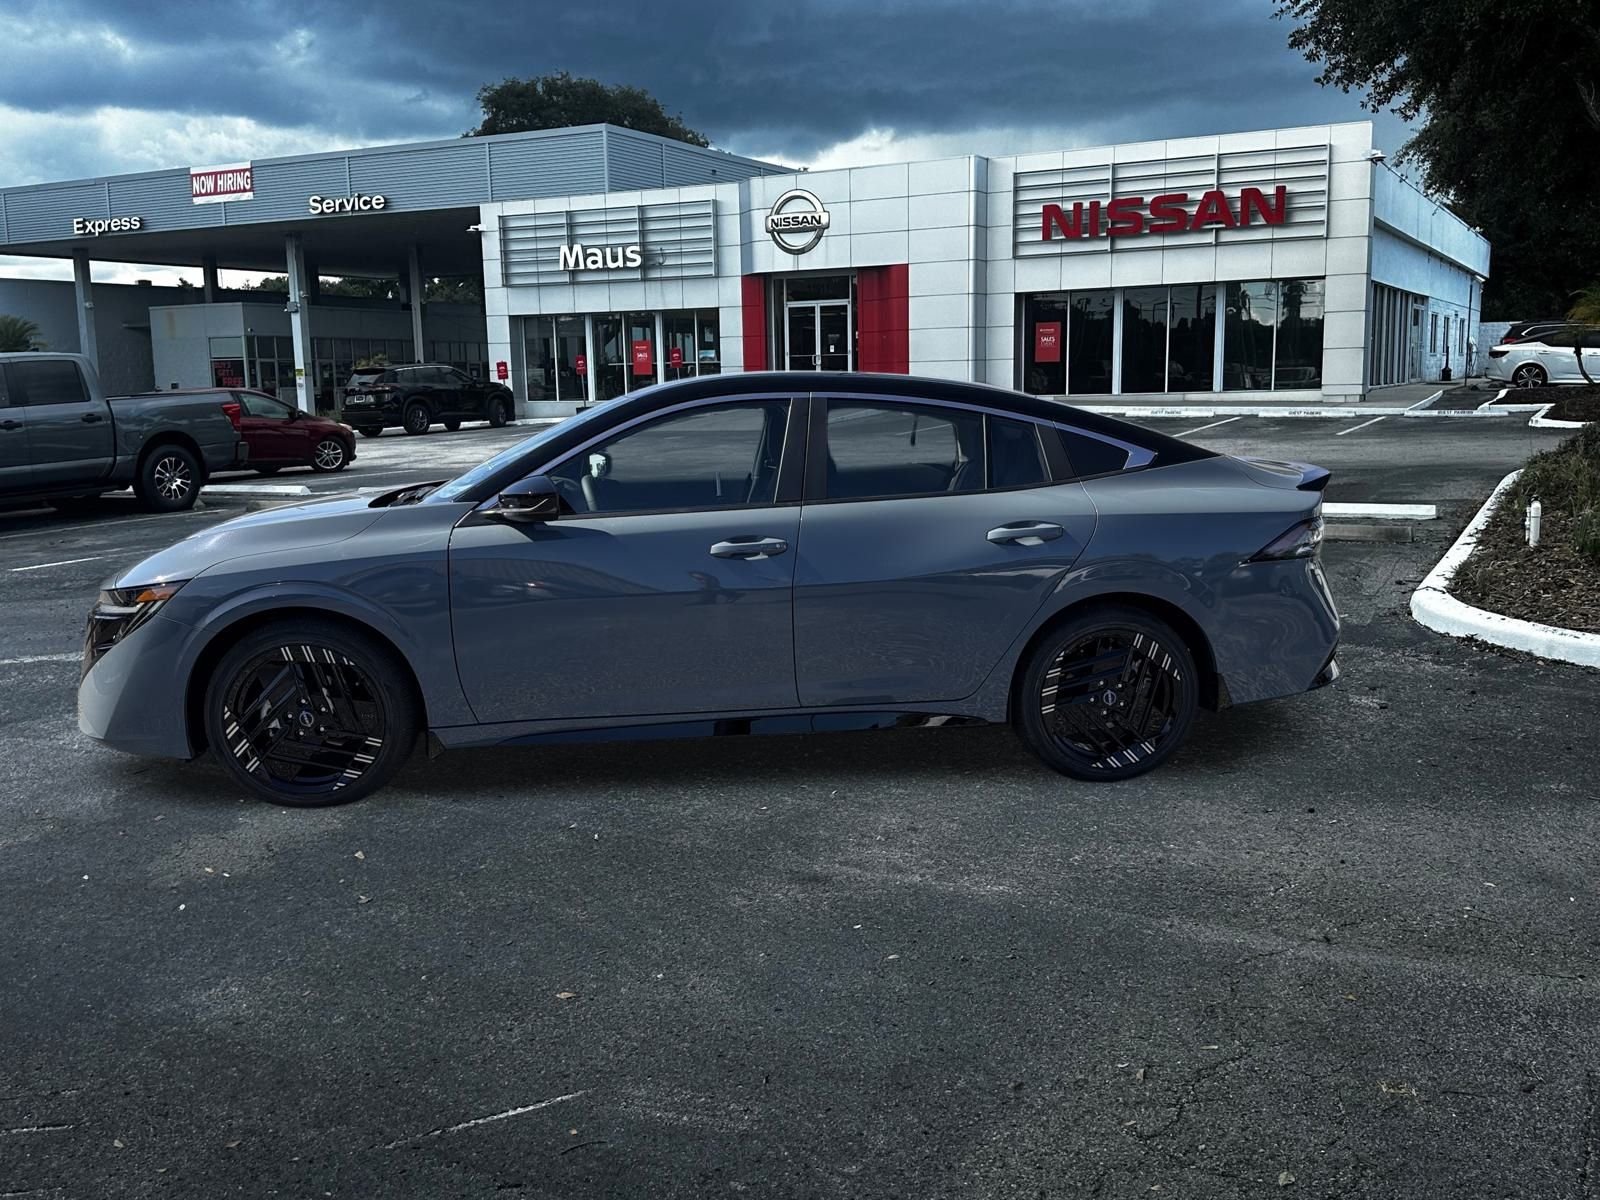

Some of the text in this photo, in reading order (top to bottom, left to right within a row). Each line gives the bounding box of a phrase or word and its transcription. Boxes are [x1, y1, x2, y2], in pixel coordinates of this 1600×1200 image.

[193, 171, 251, 195] NOW HIRING
[309, 193, 385, 214] Service
[1042, 185, 1287, 241] NISSAN
[73, 216, 141, 236] Express
[770, 214, 822, 228] NISSAN
[559, 243, 642, 271] Maus
[223, 377, 244, 386] FREE
